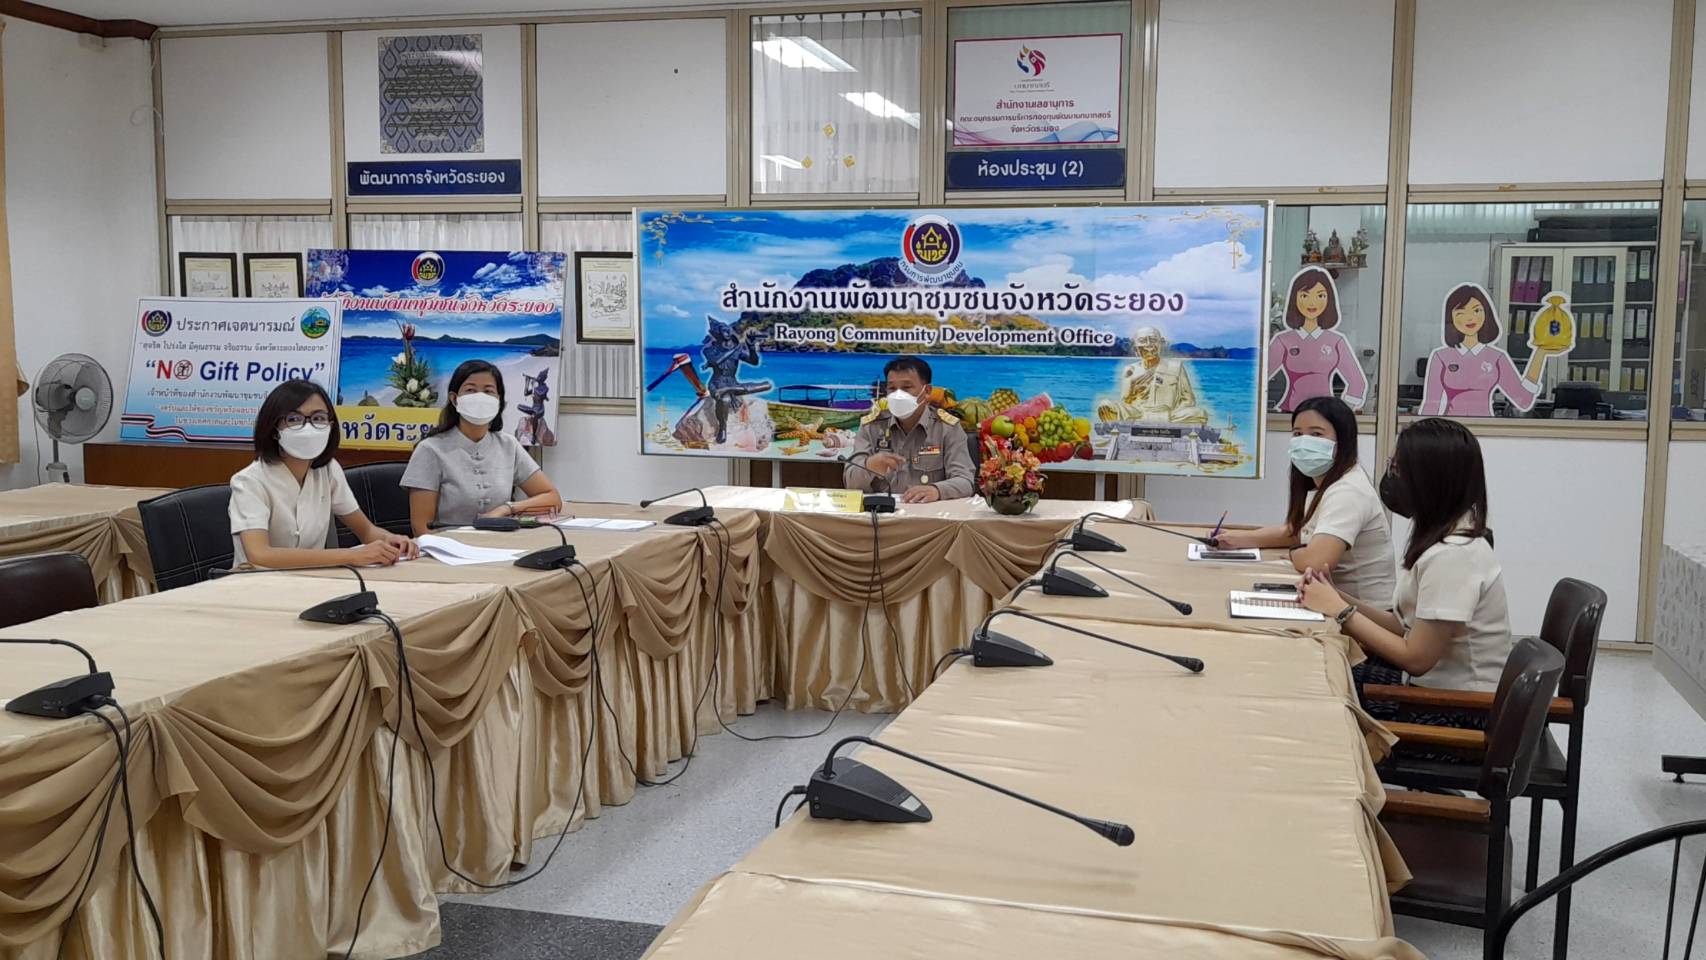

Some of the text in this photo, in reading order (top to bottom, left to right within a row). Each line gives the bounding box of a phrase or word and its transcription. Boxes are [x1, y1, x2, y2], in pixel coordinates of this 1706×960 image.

[359, 168, 505, 186] พัฒนาการจังหวัดระยอง
[977, 159, 1084, 181] ห้องประชุม (2)
[900, 261, 964, 284] กรมการพัฒนาชุมชน
[722, 281, 1184, 318] สำนักงานพัฒนาชุมชนจังหวัดระยอง
[176, 316, 296, 332] ประกาศเจตนารมณ์
[776, 325, 1114, 346] Rayong Community Development Office
[199, 360, 240, 381] Gift
